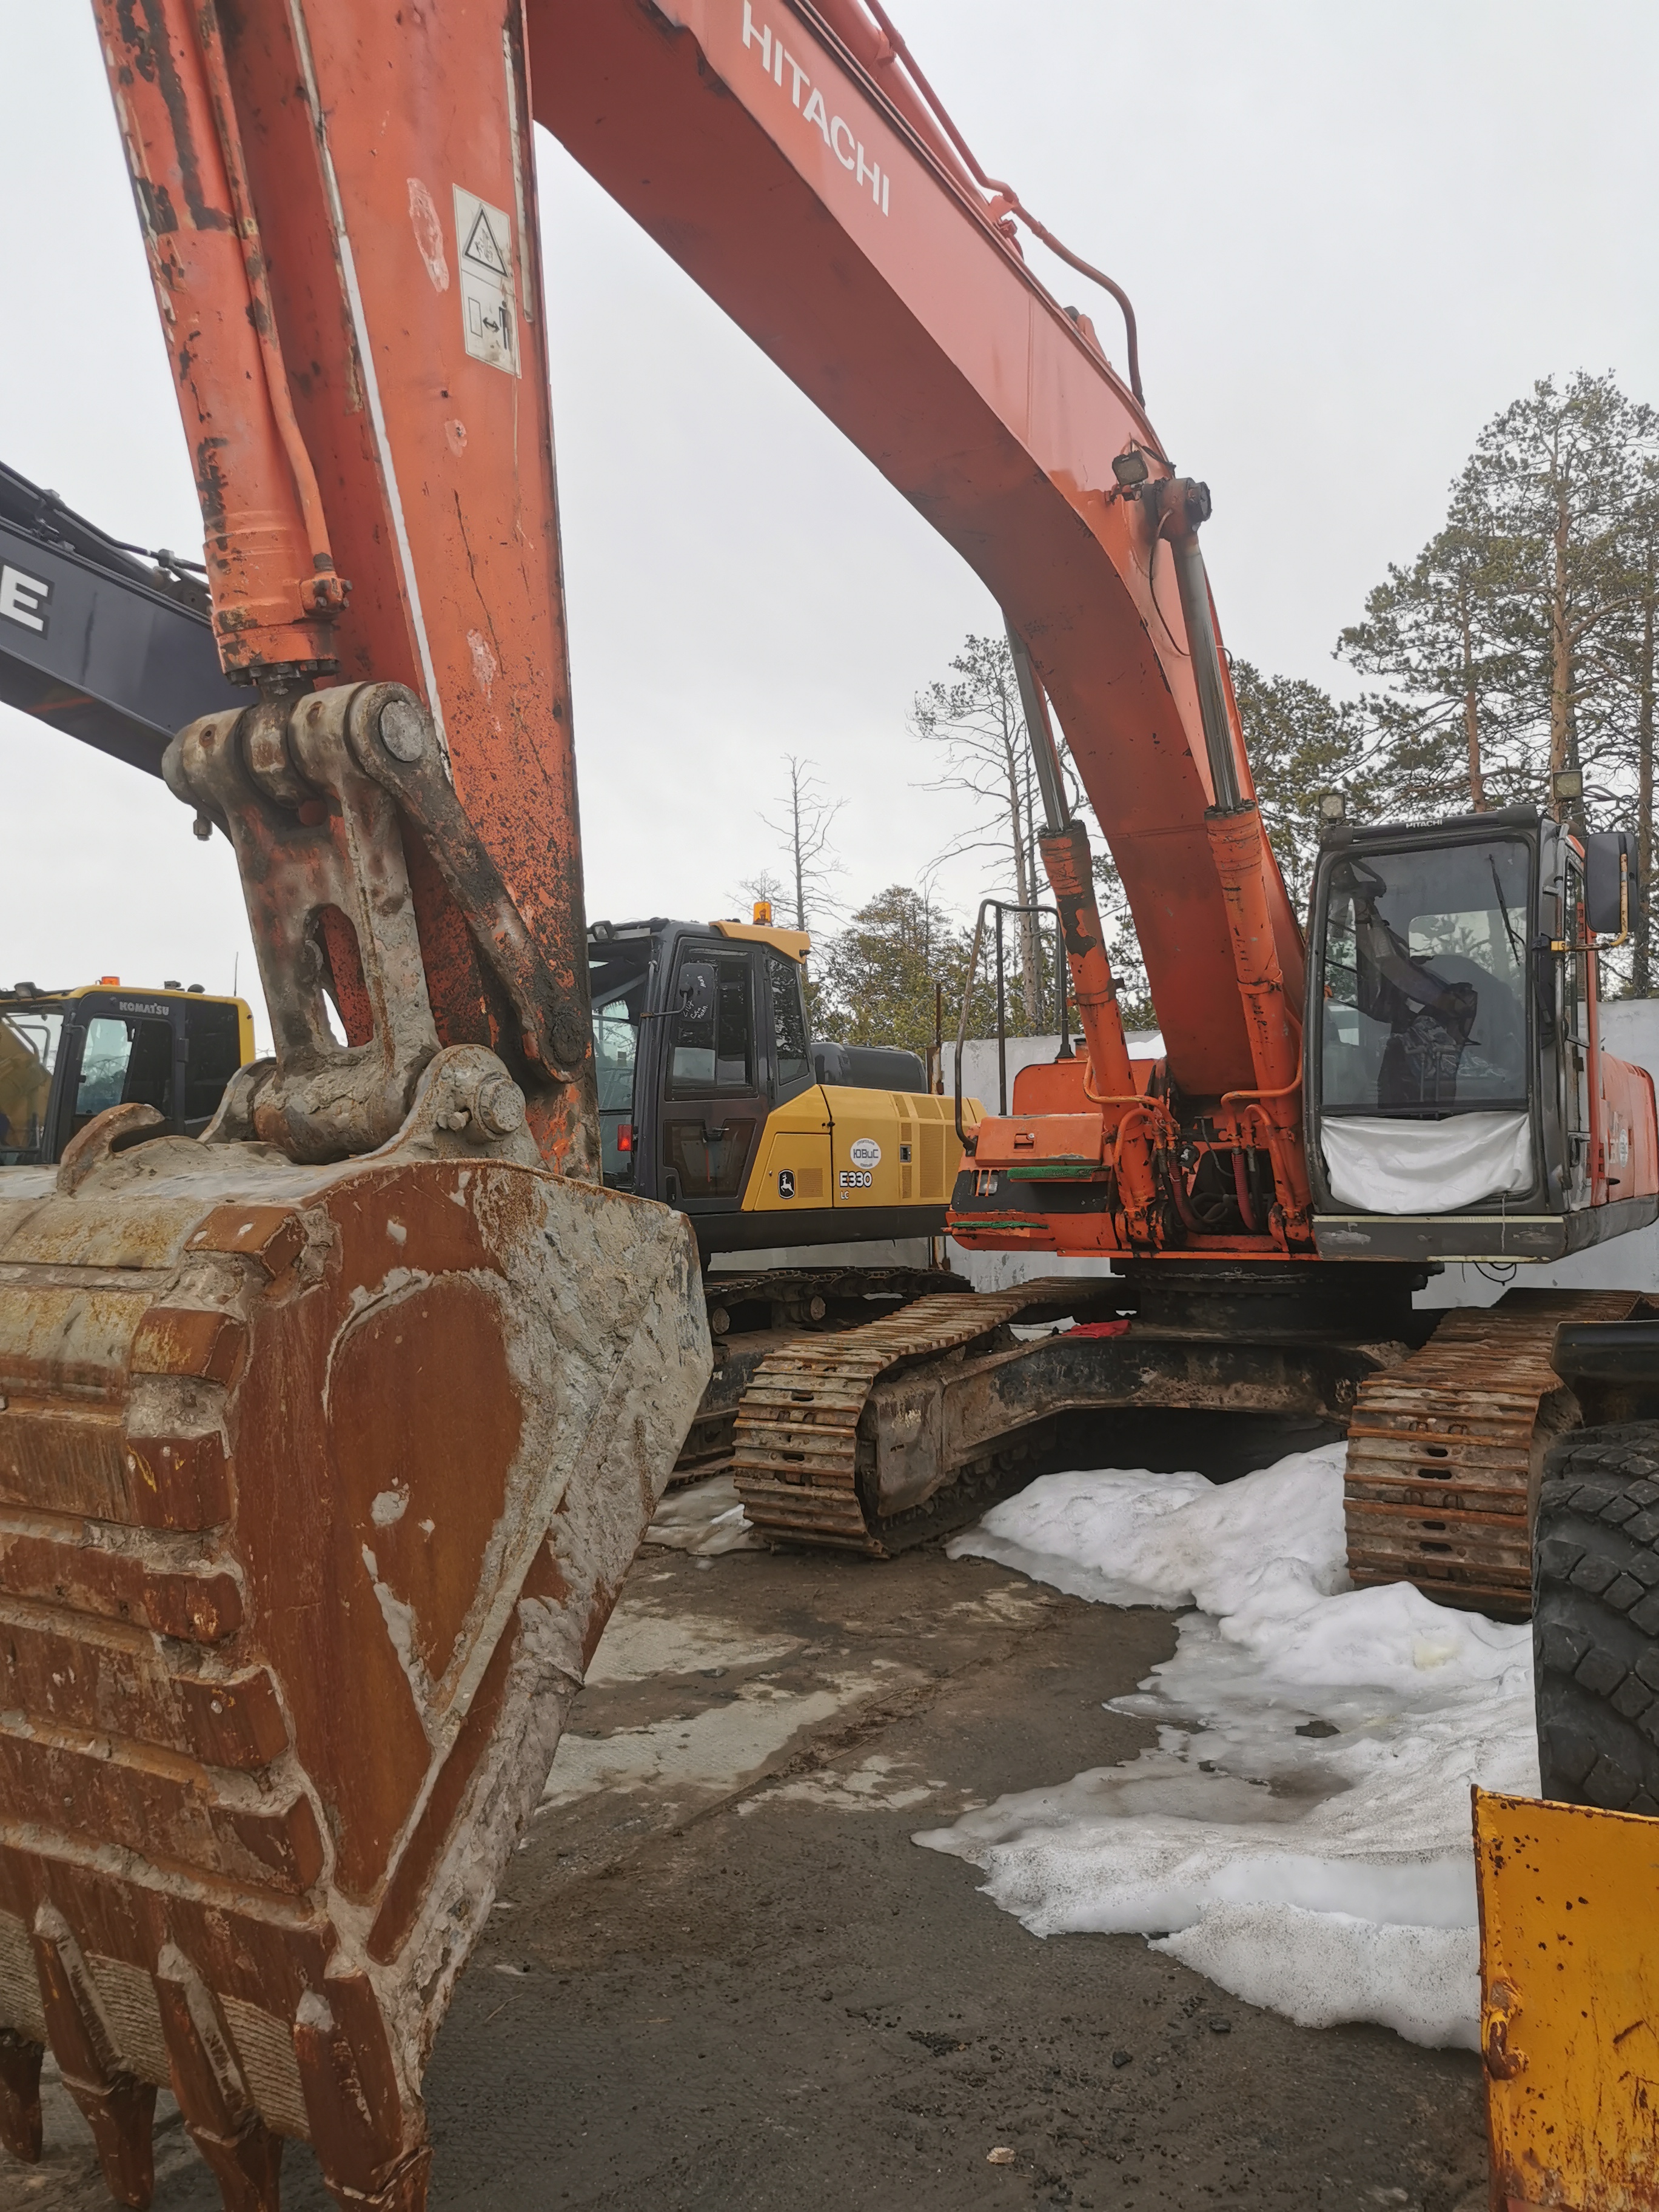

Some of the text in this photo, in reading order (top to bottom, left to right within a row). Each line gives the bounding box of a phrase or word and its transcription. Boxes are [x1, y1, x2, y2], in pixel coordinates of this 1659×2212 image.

[743, 0, 889, 216] HITACHI
[1406, 819, 1443, 829] HITACHI
[119, 1001, 169, 1016] KOMATSU
[839, 1171, 873, 1188] E330
[840, 1190, 850, 1200] LC
